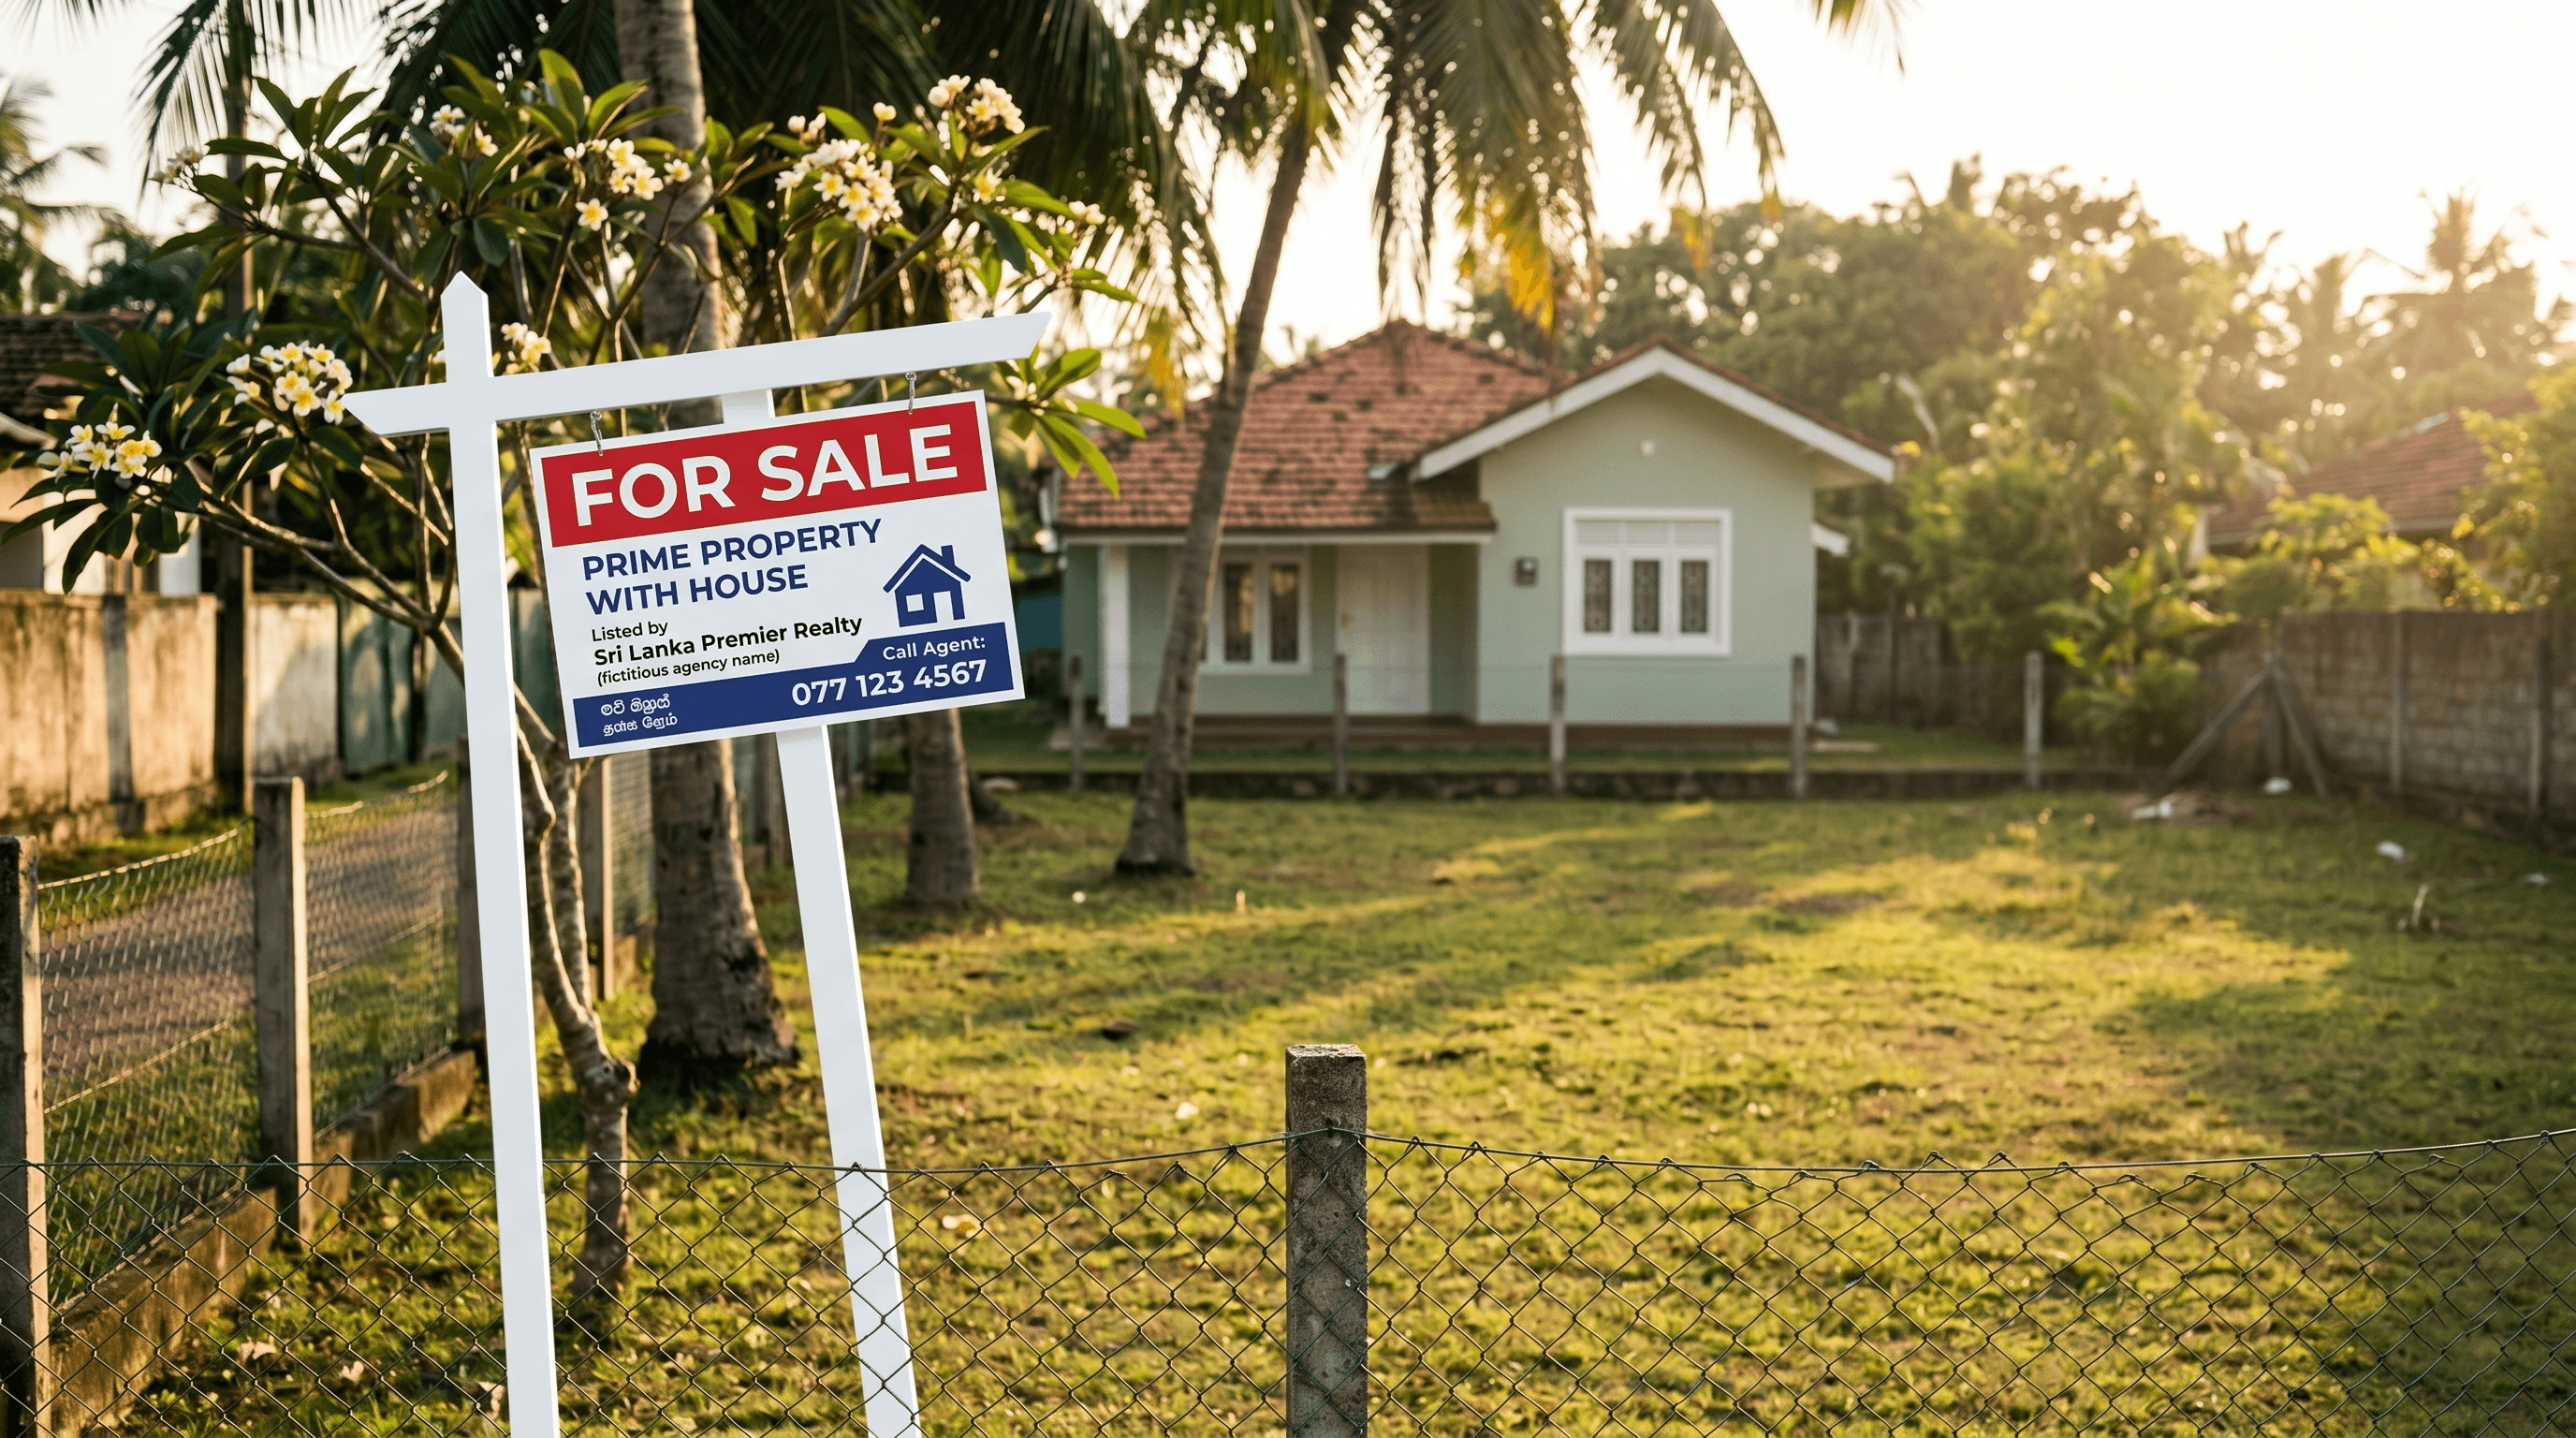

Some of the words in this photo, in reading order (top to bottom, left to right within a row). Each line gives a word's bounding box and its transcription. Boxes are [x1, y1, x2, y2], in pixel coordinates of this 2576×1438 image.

[572, 456, 737, 526] FOR
[758, 424, 959, 502] SALE
[583, 544, 692, 580] PRIME
[700, 519, 882, 565] PROPERTY
[586, 581, 679, 615] WITH
[690, 565, 808, 602] HOUSE
[592, 622, 643, 641] Listed
[648, 621, 668, 636] by
[594, 645, 622, 666] Sri
[629, 638, 695, 661] Lanka
[701, 625, 788, 652] Premier
[793, 616, 862, 640] Realty
[883, 643, 917, 661] Call
[923, 636, 986, 657] Agent:
[597, 666, 669, 687] (fictitious
[673, 658, 728, 676] agency
[732, 648, 780, 667] name)
[792, 677, 847, 706] 077
[856, 670, 905, 697] 123
[914, 659, 988, 688] 4567
